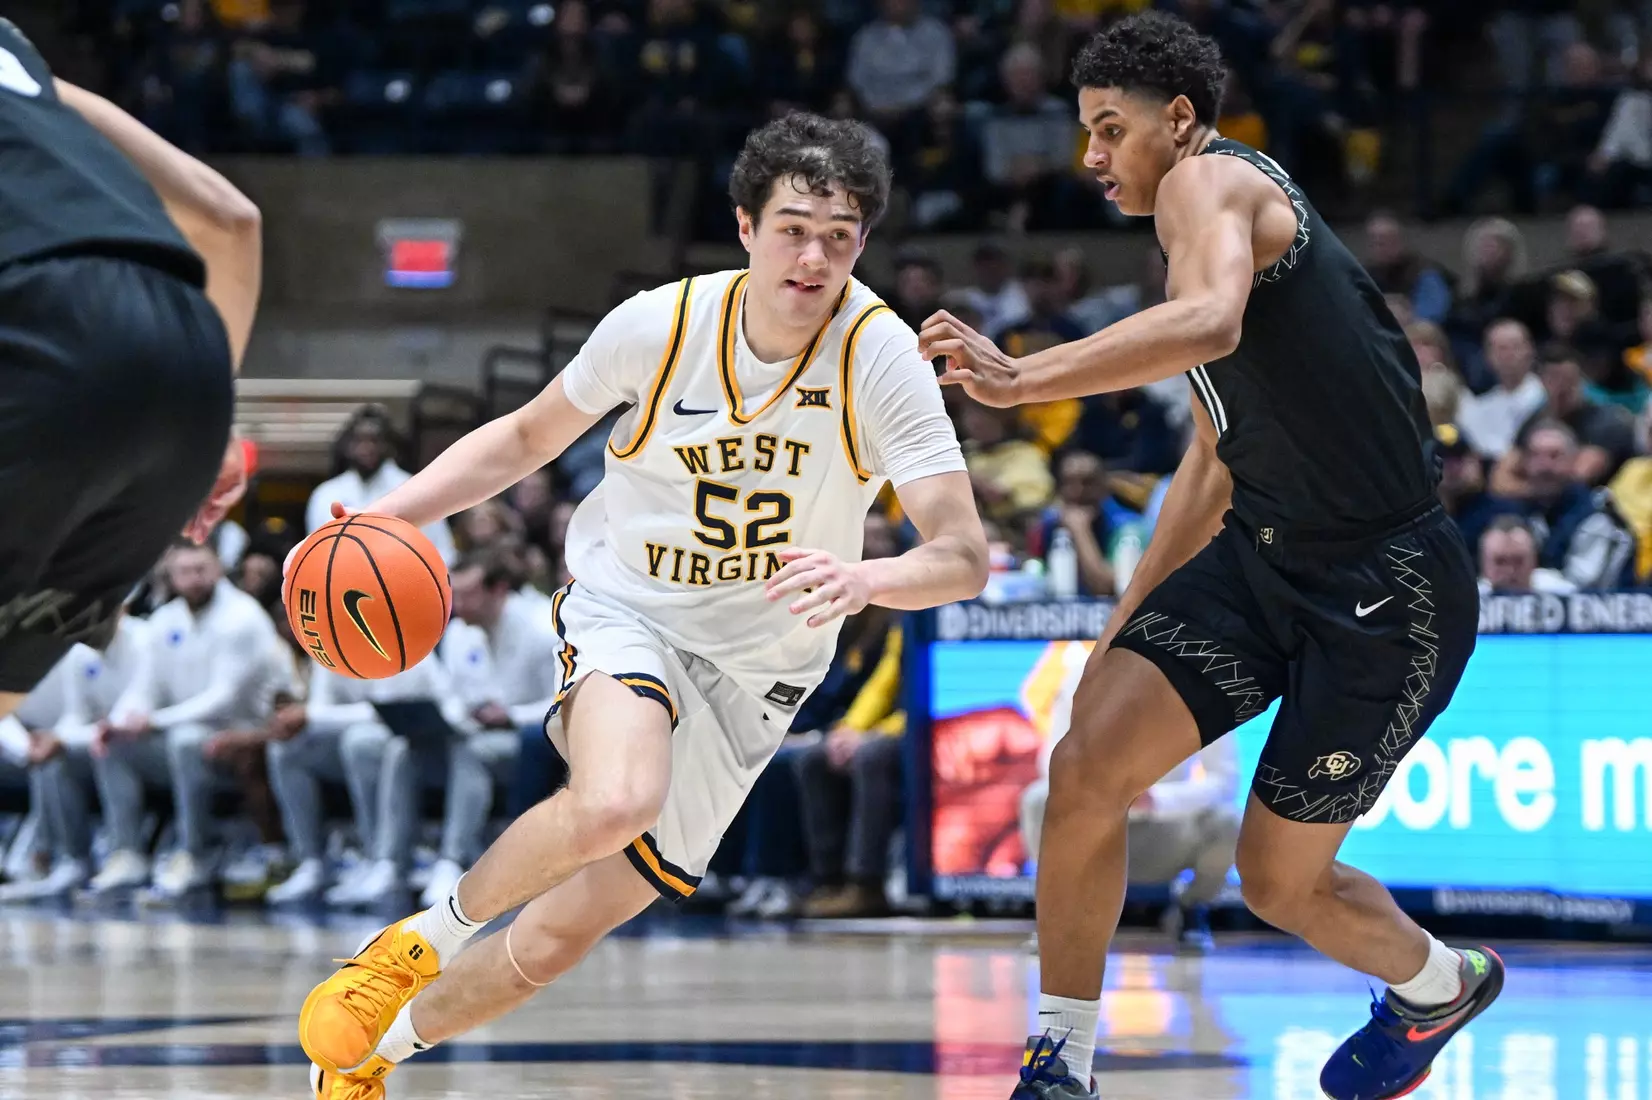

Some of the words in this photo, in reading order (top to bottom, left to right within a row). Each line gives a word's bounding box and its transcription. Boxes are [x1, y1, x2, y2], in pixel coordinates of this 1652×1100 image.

[795, 387, 832, 410] XII
[672, 432, 812, 476] WEST
[692, 477, 794, 550] 52
[645, 541, 812, 594] VIRGIN
[299, 588, 337, 668] ELITE
[968, 602, 1112, 639] DIVERSIFIE
